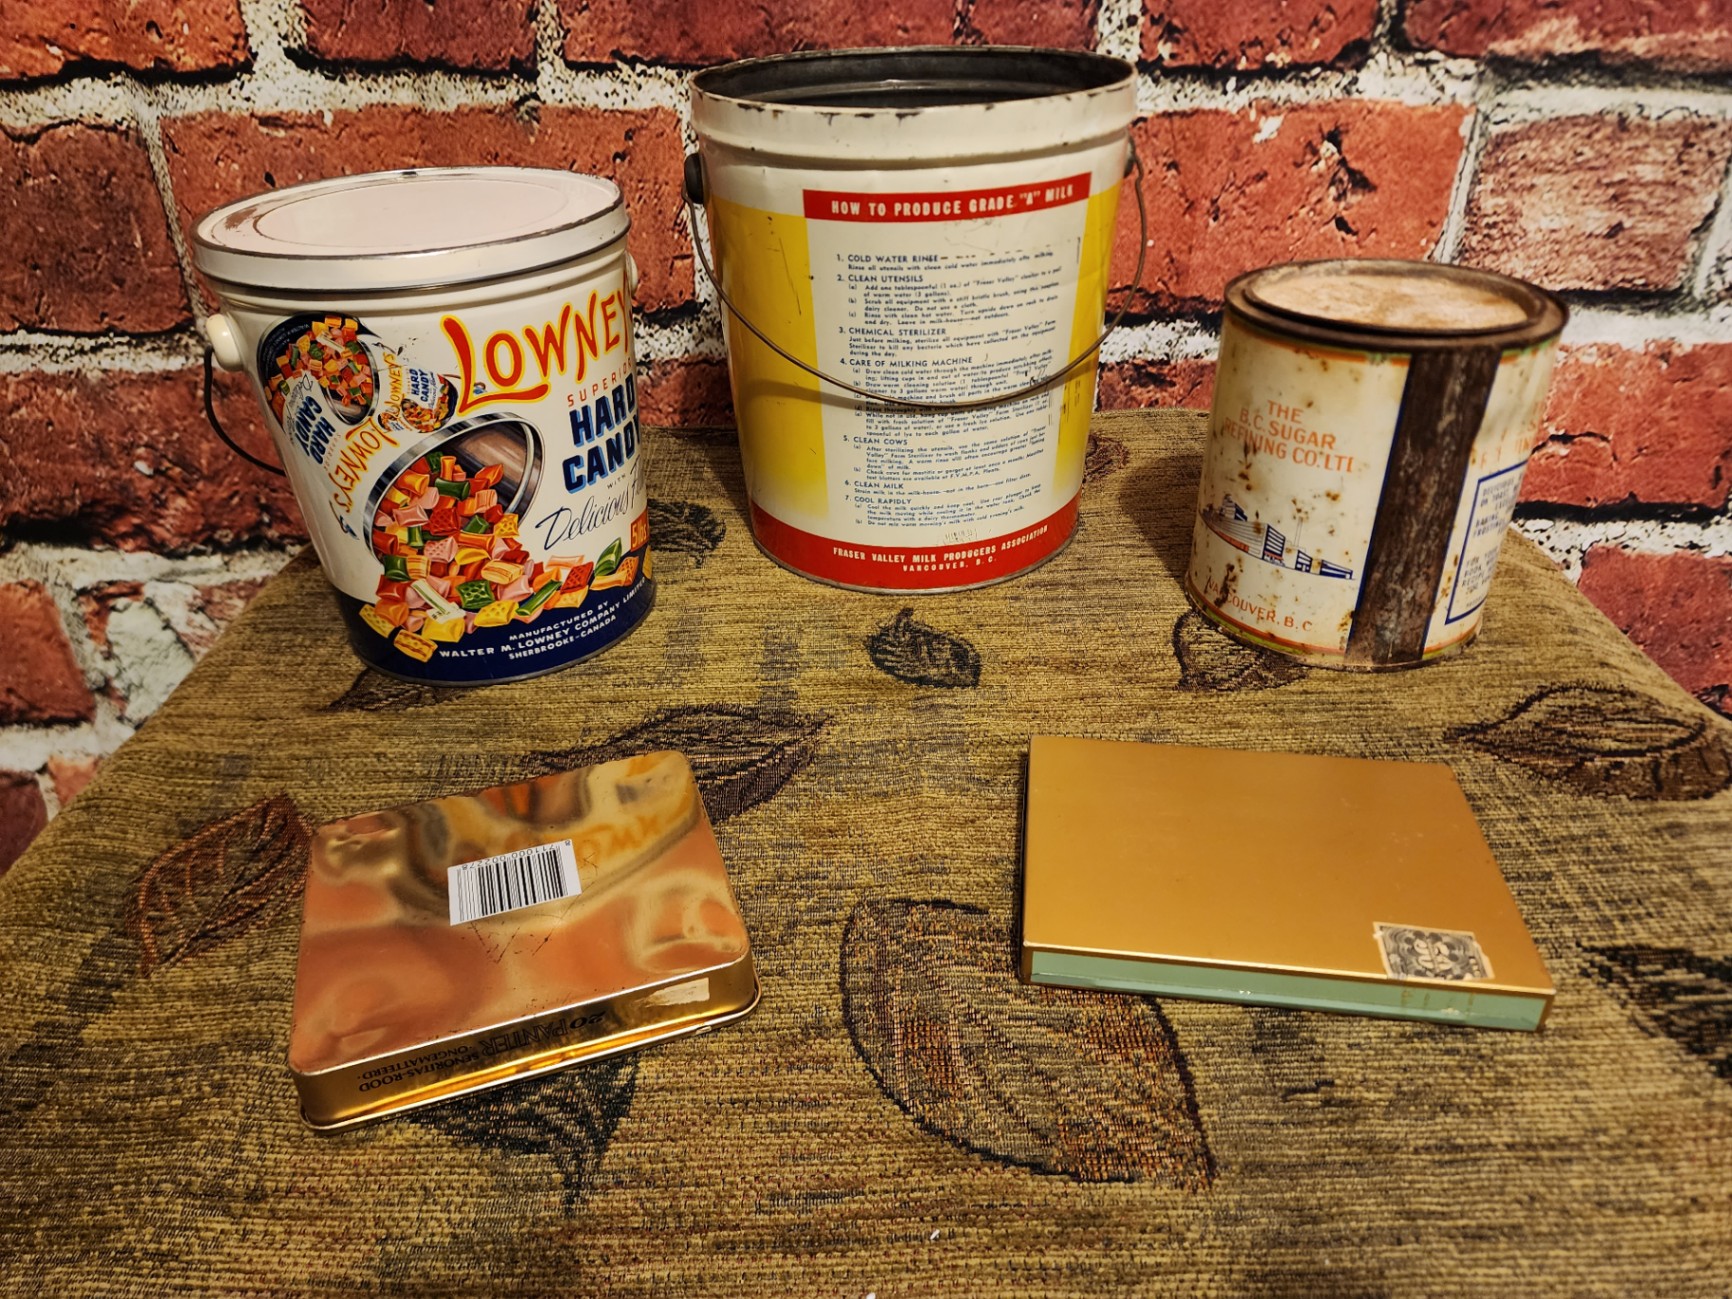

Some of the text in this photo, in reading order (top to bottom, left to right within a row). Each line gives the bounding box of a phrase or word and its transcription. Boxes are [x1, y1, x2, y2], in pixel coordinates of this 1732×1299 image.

[832, 184, 1073, 216] HOW TO PRODUCE GRADE "A" MILK
[837, 254, 844, 262] 1.
[848, 254, 871, 262] COLD
[440, 268, 633, 416] LOWNEY
[932, 356, 973, 366] MACHINE
[409, 368, 420, 396] HARD
[418, 368, 430, 402] CANDY
[567, 356, 634, 408] SUPERIOR
[295, 396, 322, 457] CANDY
[569, 371, 636, 448] HARD
[1267, 399, 1304, 425] THE
[310, 416, 336, 464] HARD
[1268, 420, 1337, 450] SUGAR
[328, 416, 398, 514] LOWNEY'S
[1292, 446, 1320, 468] CO.
[534, 482, 630, 550] Delicious
[833, 524, 1049, 563] FRASER VALLEY MILK PRODUCERS ASSOCIATION
[439, 578, 647, 658] WALTER M. LOWNEY COMPANY LIMITED
[508, 601, 609, 641] MANUFACTURED BY
[1205, 578, 1280, 625] VACOUVER.
[462, 856, 506, 870] 002278
[511, 844, 554, 859] 711000
[478, 1010, 606, 1056] 20 PANTER
[358, 1052, 478, 1092] SENORITAS-ROOD
